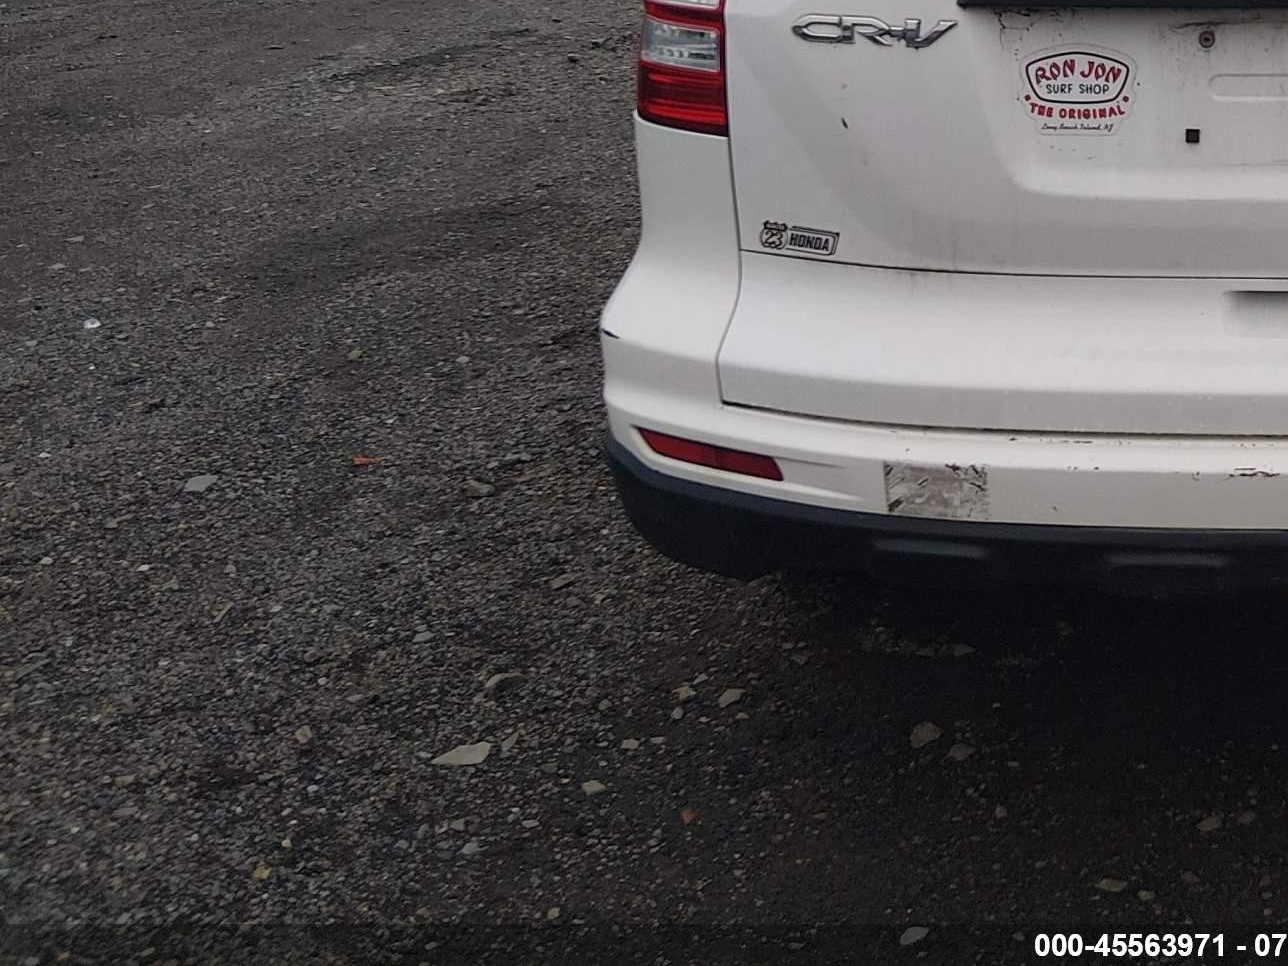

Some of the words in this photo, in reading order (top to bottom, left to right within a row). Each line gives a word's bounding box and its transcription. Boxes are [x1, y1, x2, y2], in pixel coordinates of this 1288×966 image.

[791, 13, 958, 48] CR-V
[1035, 58, 1076, 85] RON
[1080, 60, 1122, 83] JON
[1046, 84, 1073, 94] SURF
[1079, 84, 1110, 95] SHOP
[1029, 102, 1053, 117] THE
[1058, 105, 1125, 119] ORIGINAL
[764, 230, 783, 249] 23
[788, 232, 830, 251] HONDA
